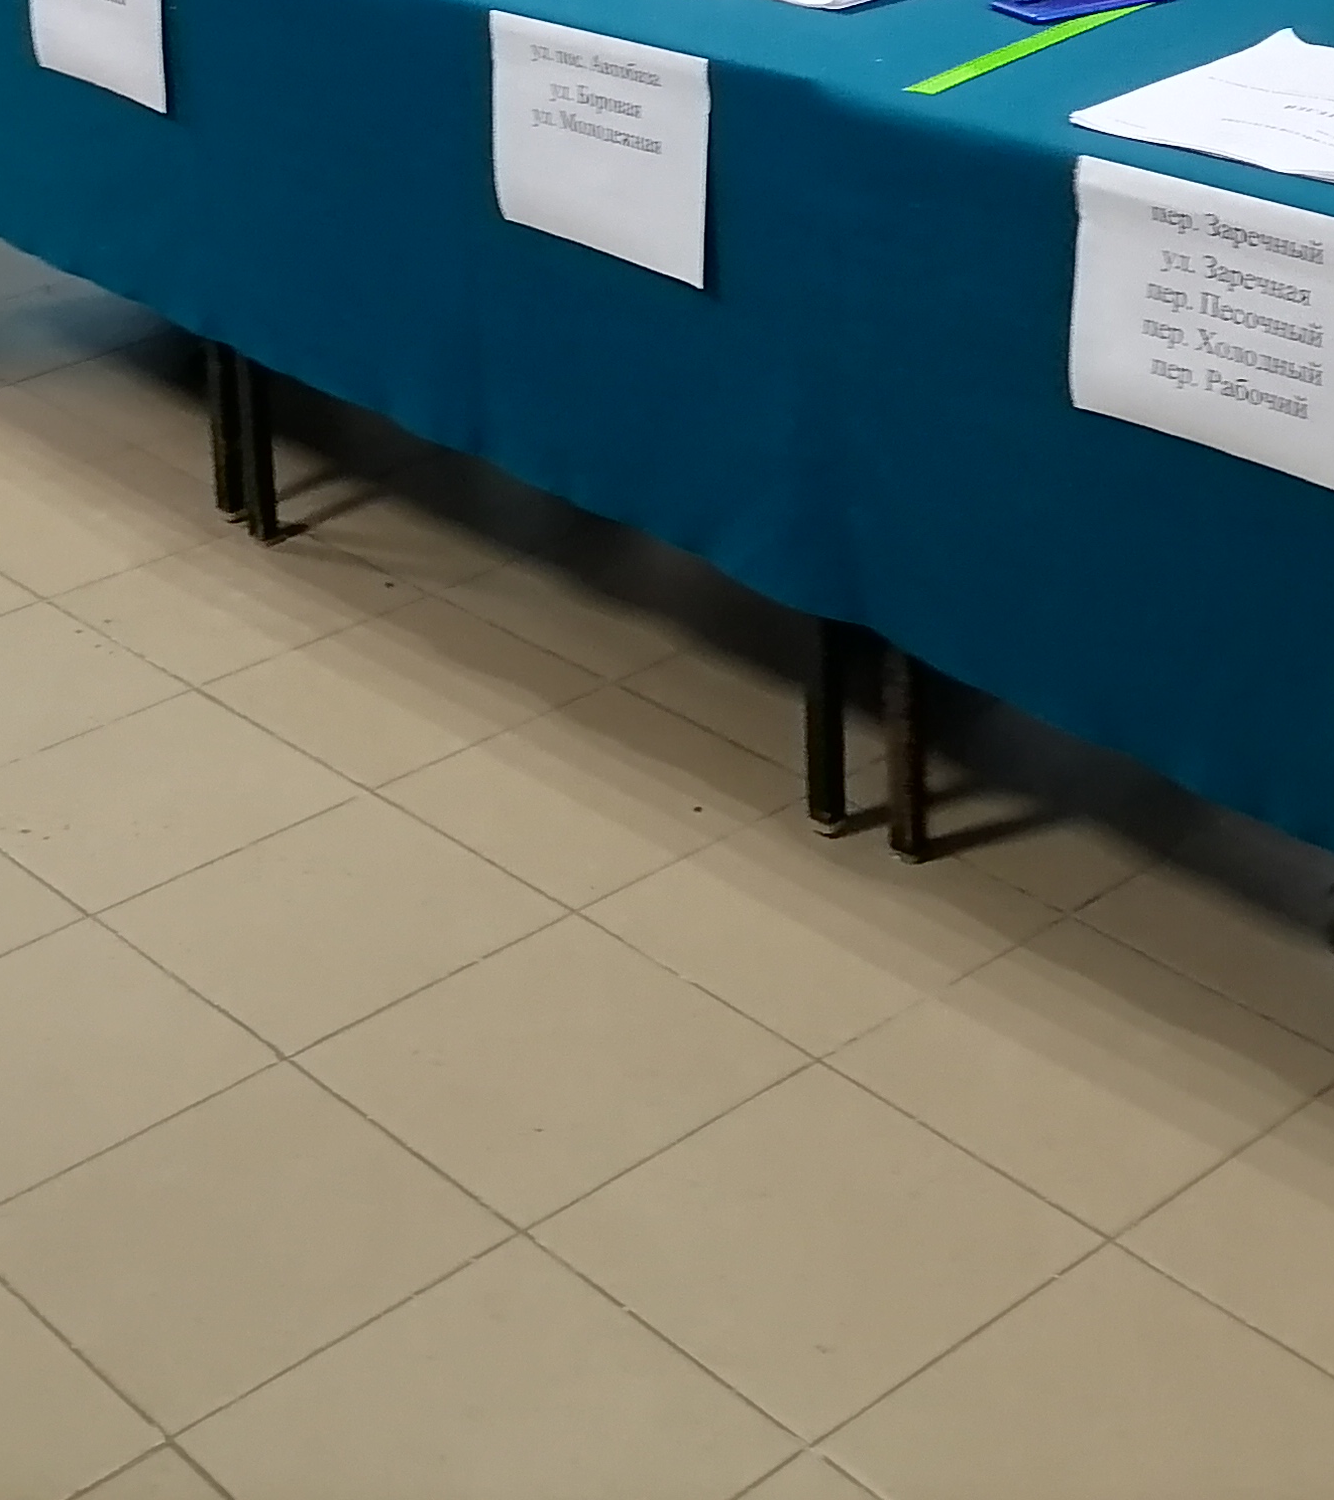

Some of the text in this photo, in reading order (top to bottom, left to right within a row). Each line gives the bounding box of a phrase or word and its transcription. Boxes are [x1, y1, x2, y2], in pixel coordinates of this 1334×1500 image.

[1150, 205, 1325, 265] пер. Заречный
[1160, 250, 1312, 307] ул. Заречная
[1145, 283, 1324, 348] пер. Песочный
[1141, 318, 1324, 387] пер. Холодный
[1149, 358, 1309, 421] пер. Рабочий
